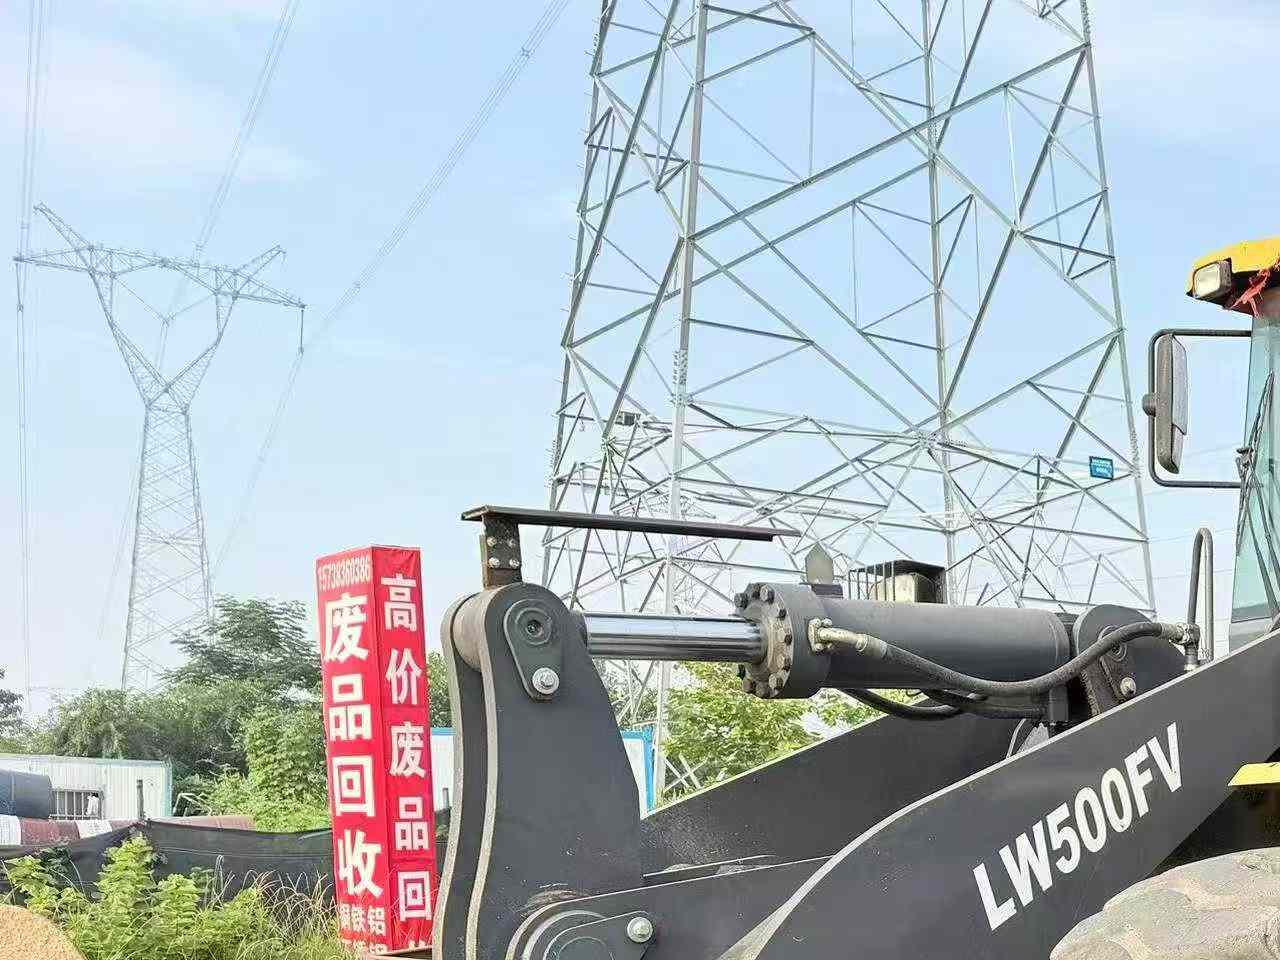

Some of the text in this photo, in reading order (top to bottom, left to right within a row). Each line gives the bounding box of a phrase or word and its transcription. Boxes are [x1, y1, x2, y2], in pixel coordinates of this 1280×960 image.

[323, 592, 384, 898] 废品回收
[381, 573, 433, 948] 高价废品回
[972, 721, 1182, 931] LW500FV
